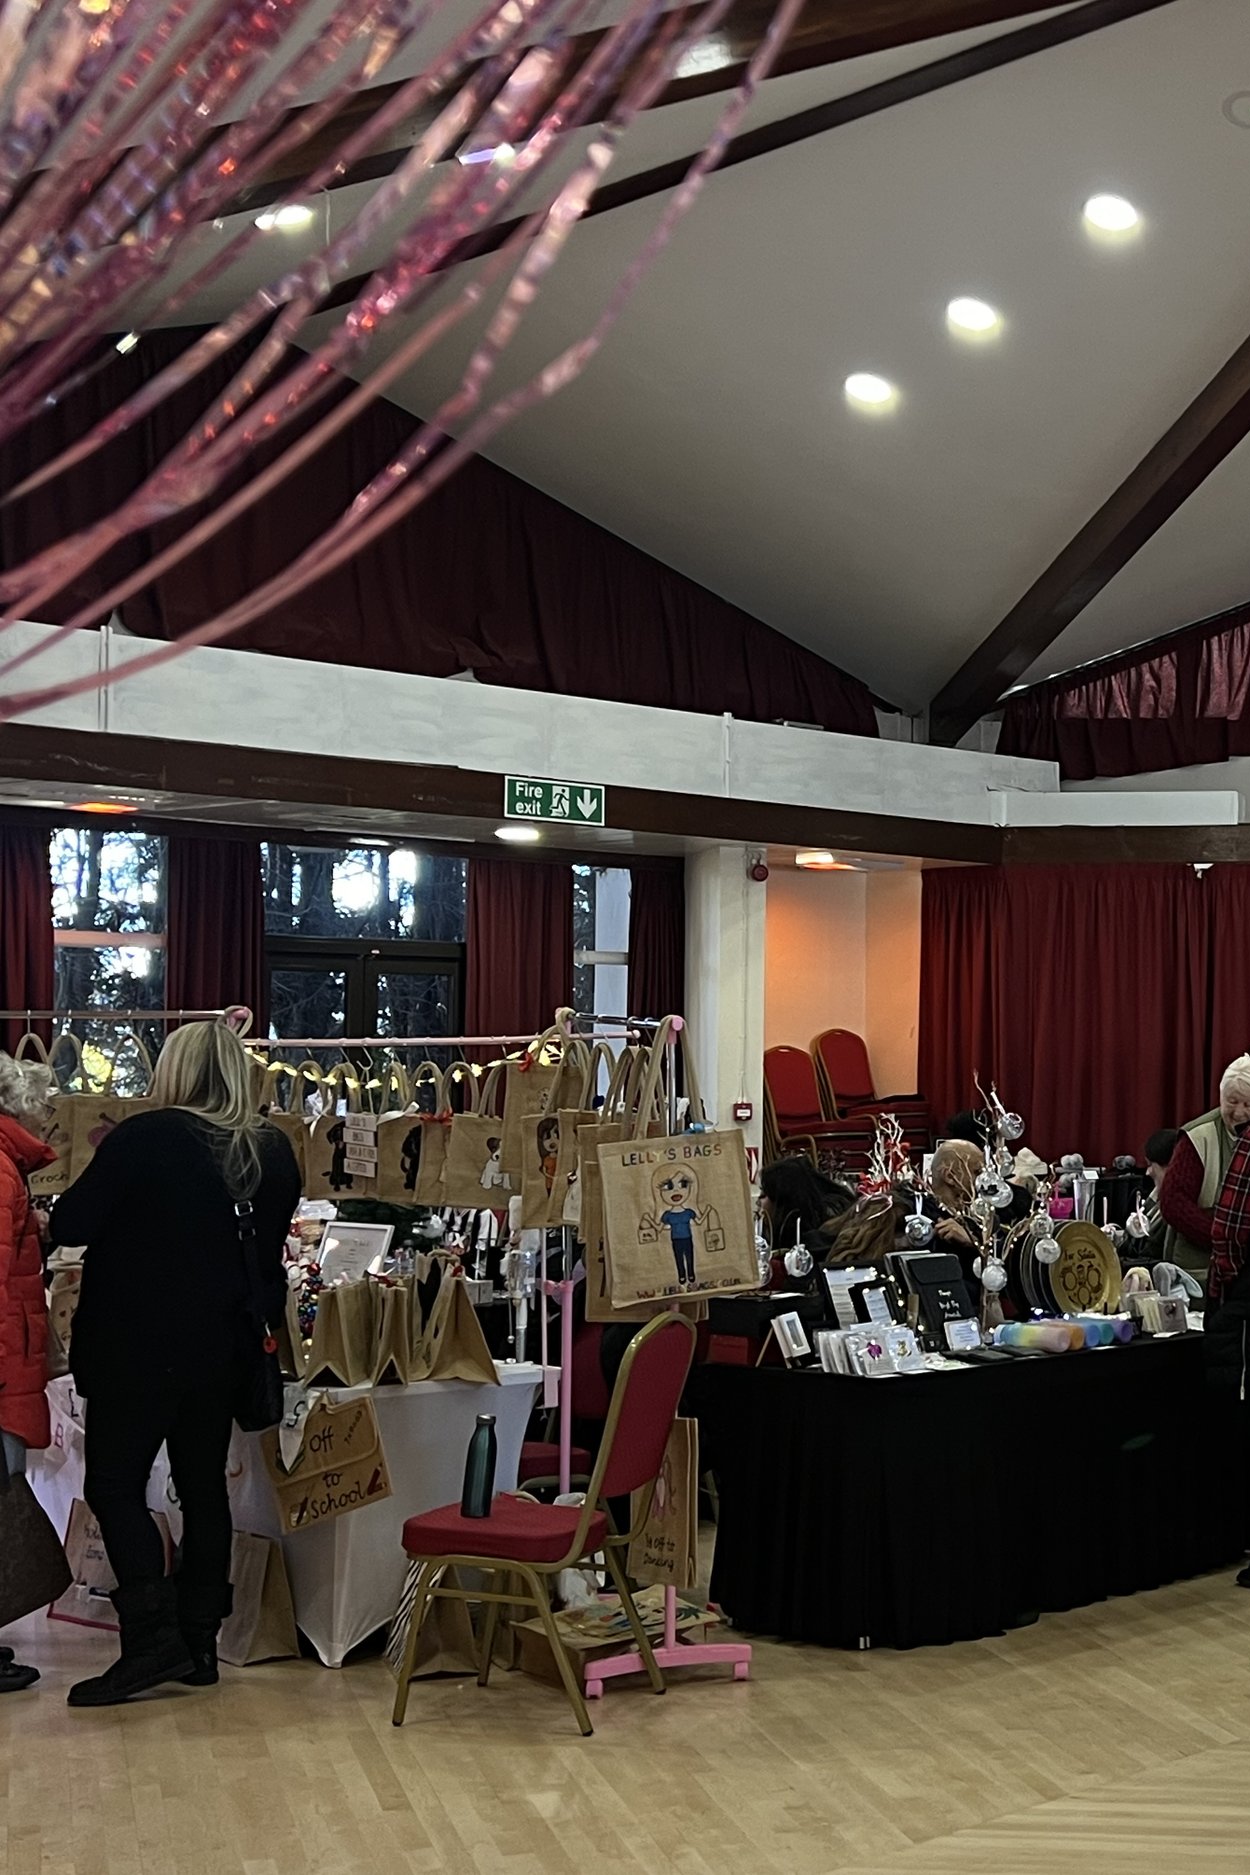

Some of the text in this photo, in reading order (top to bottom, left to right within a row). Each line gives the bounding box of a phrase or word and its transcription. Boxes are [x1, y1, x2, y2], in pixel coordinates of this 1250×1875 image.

[515, 782, 543, 798] Fire
[515, 800, 541, 815] exit
[683, 1144, 722, 1159] BAGS
[309, 1425, 334, 1453] Off
[322, 1472, 343, 1488] to
